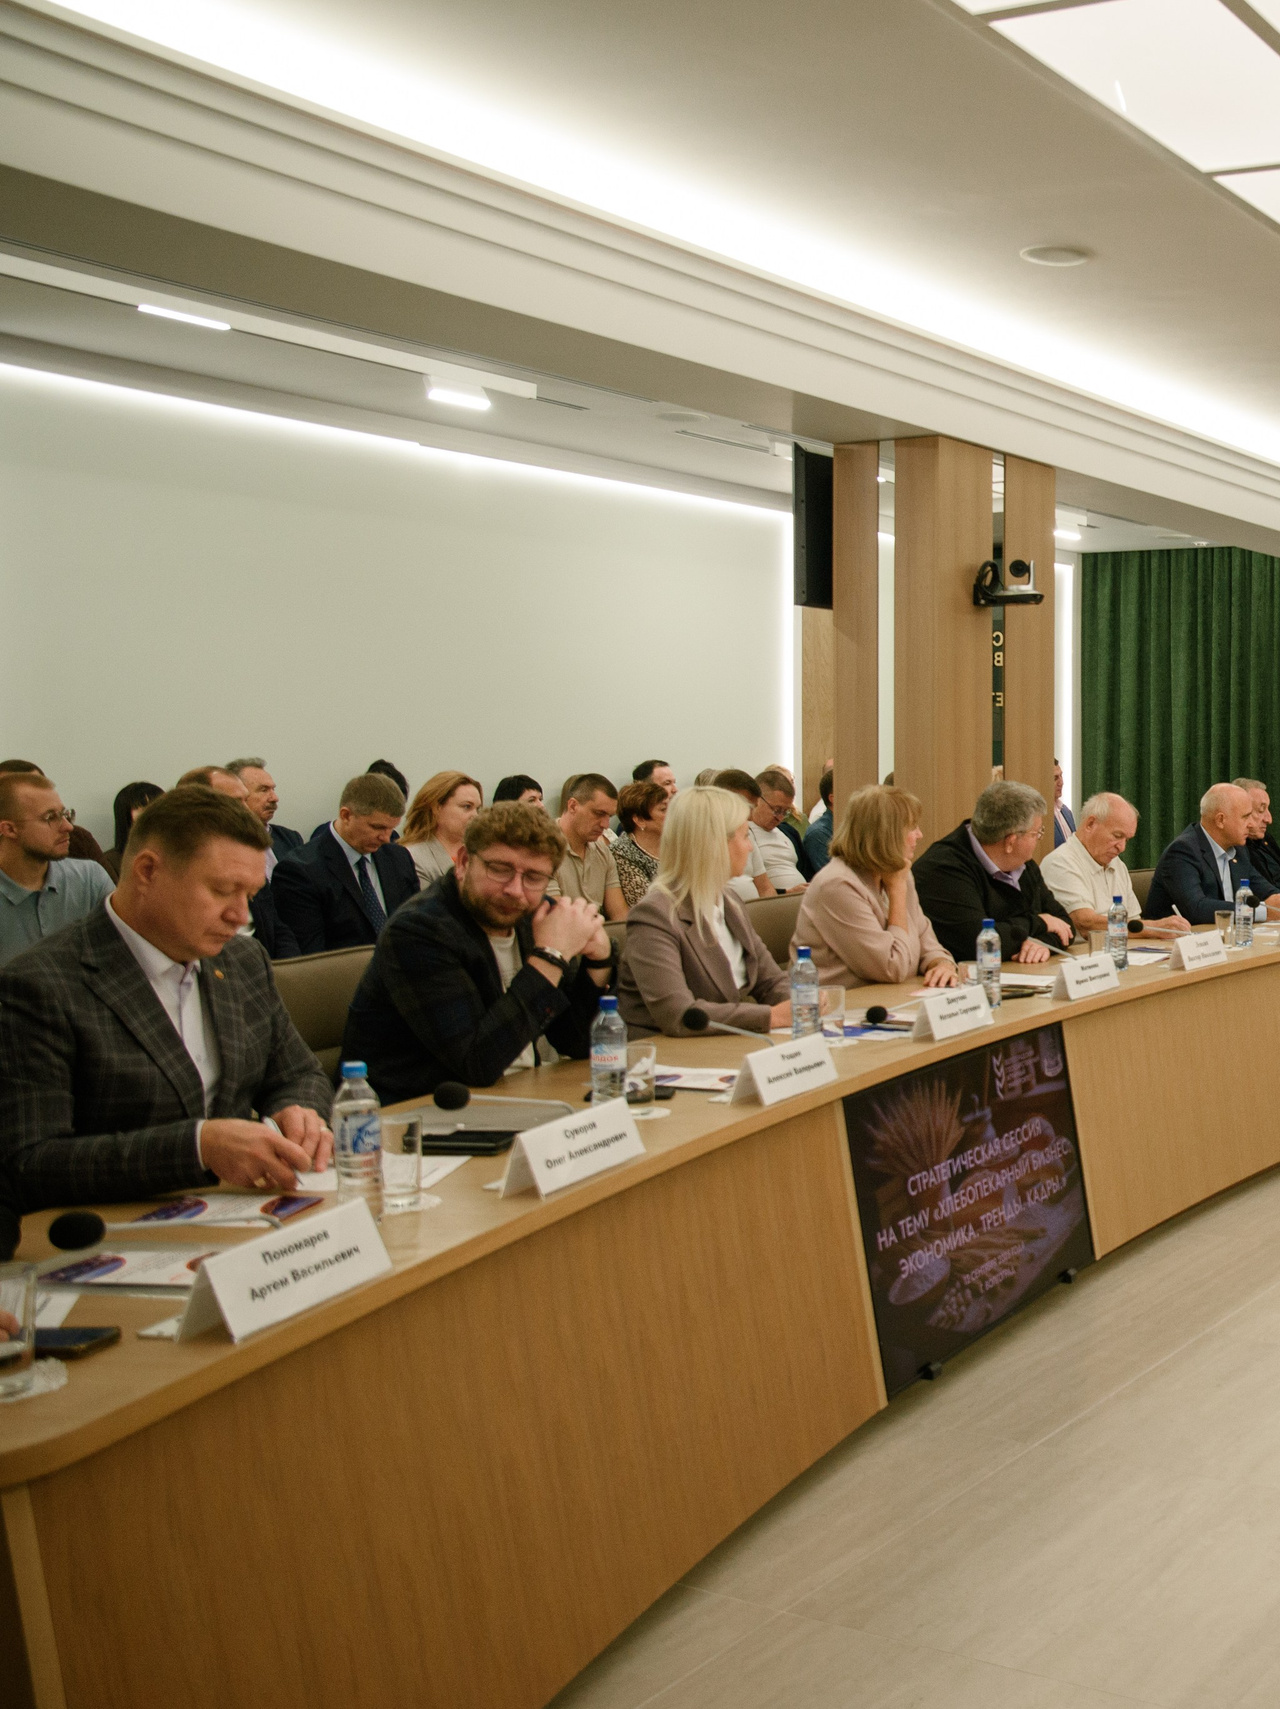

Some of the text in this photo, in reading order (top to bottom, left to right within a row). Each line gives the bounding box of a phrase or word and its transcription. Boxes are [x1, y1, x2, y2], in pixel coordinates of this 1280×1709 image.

[545, 1131, 628, 1169] Олег Александрович
[563, 1121, 597, 1140] Суворов
[907, 1118, 1041, 1196] СТРАТЕГИЧЕСКАЯ СЕССИЯ
[261, 1229, 330, 1265] Пономарев
[876, 1228, 898, 1251] НА
[898, 1209, 930, 1238] ТЕМУ
[899, 1223, 979, 1279] ЭКОНОМИКА.
[250, 1245, 361, 1302] Артем Васильевич
